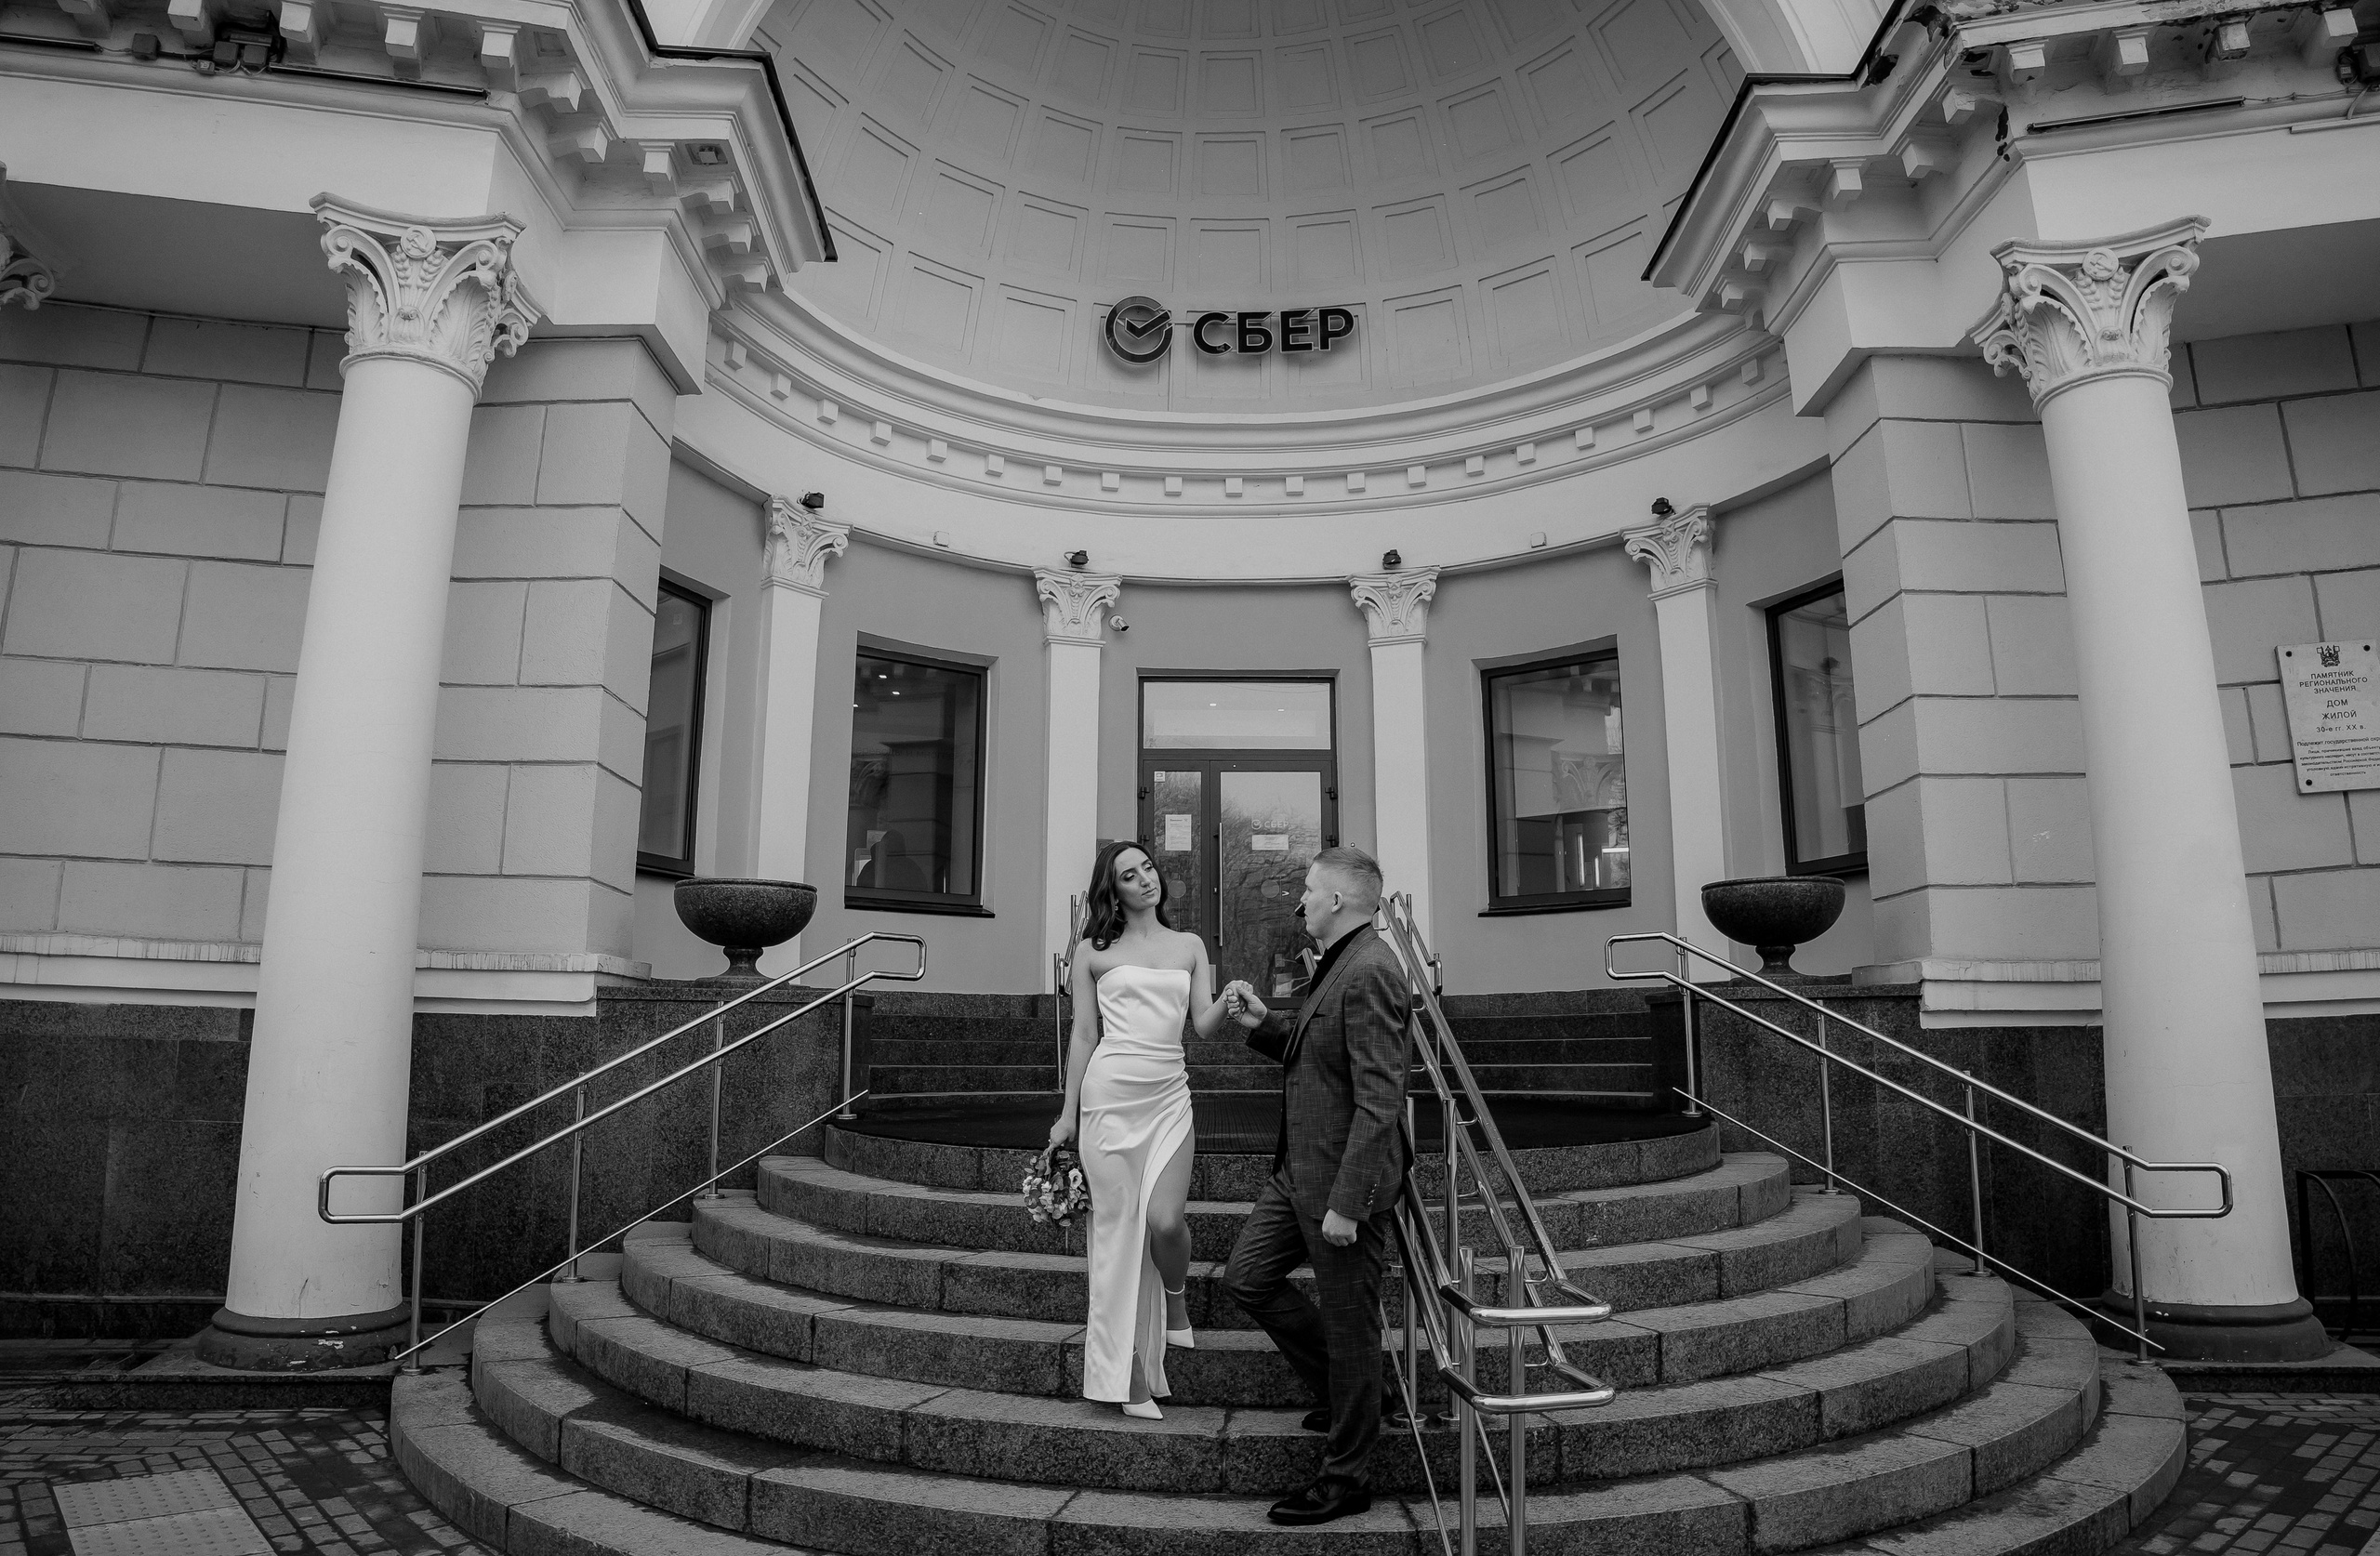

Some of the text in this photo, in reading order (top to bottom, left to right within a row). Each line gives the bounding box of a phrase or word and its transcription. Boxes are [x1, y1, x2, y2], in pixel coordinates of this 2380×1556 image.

[1192, 308, 1355, 356] СБЕР
[2310, 670, 2354, 679] ПАМЯТНИК
[2299, 677, 2368, 688] РЕГИОНАЛЬНОГО
[2314, 685, 2356, 694] ЗНАЧЕНИЯ
[2327, 699, 2347, 708] ДОМ
[2322, 710, 2357, 719] ЖИЛОЙ
